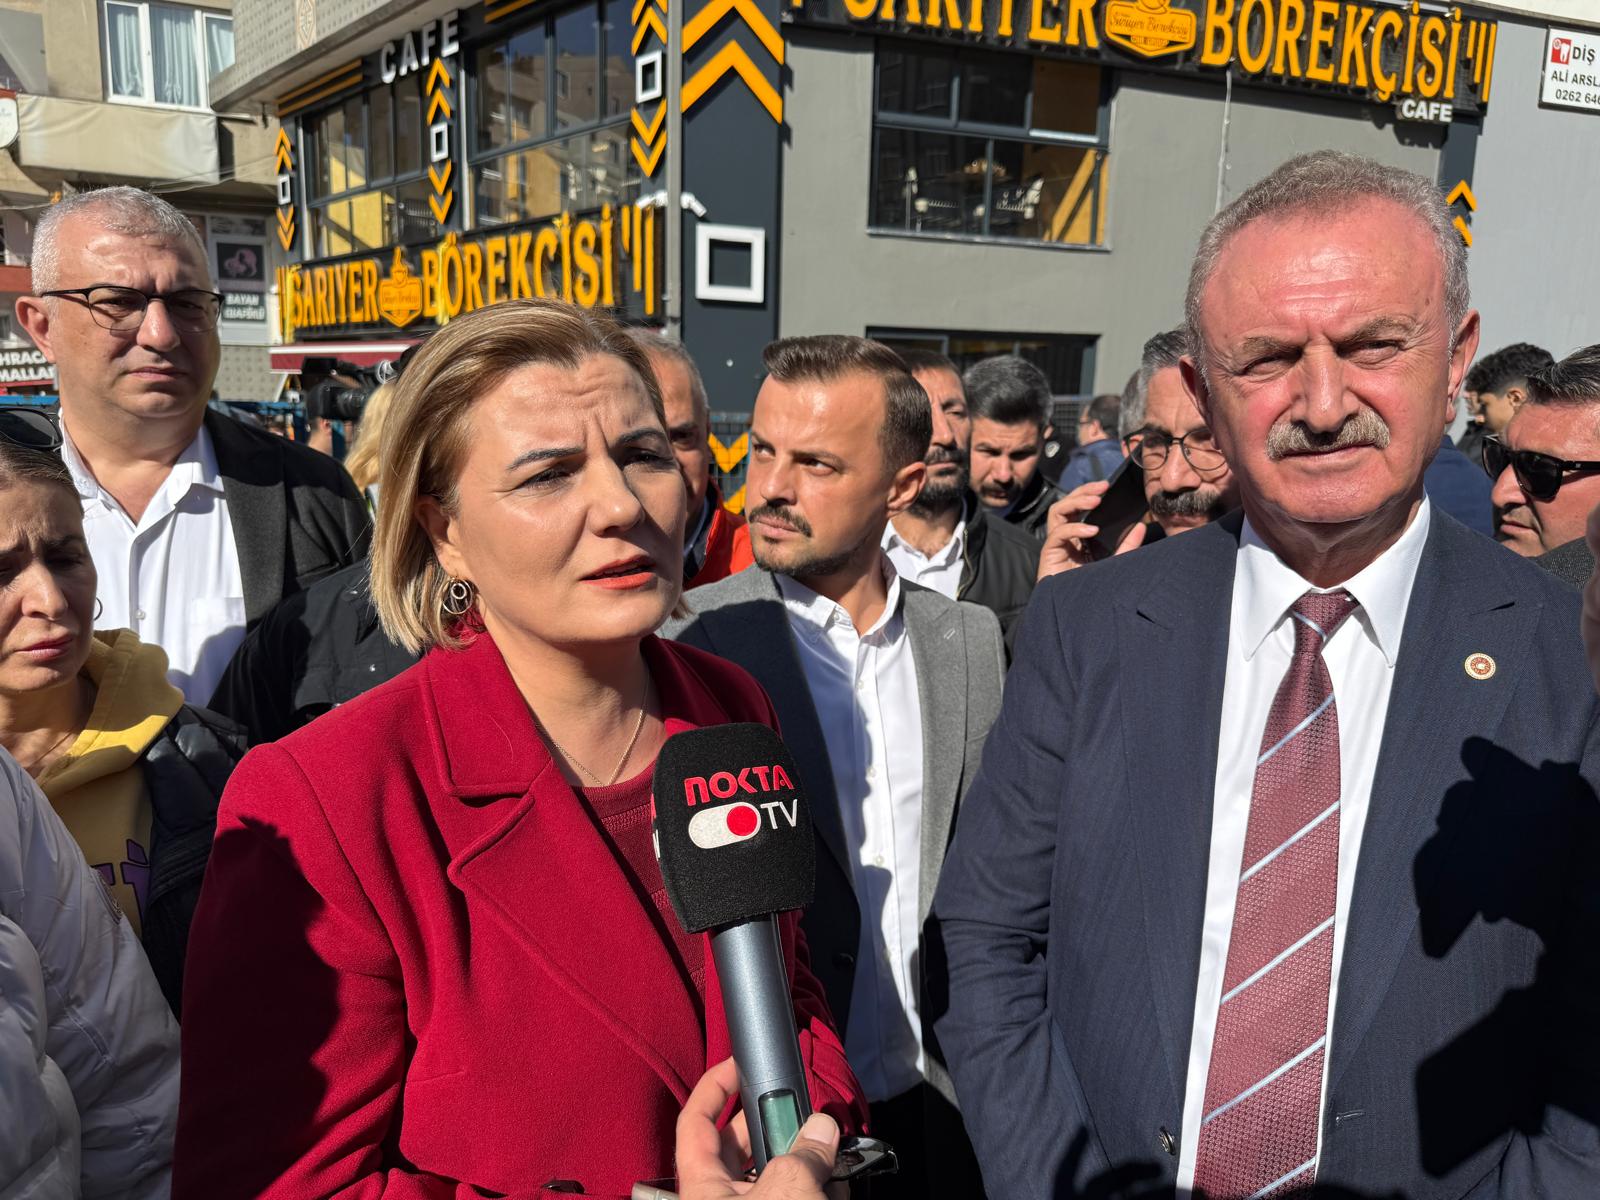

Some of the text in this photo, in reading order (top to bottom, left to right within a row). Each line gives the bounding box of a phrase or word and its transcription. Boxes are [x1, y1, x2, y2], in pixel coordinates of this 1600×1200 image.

[381, 9, 460, 84] CAFE
[1572, 45, 1596, 65] DİŞ
[1551, 69, 1600, 87] ALİ ARSL
[1555, 89, 1581, 102] 0262
[1402, 99, 1453, 122] CAFE
[290, 258, 380, 327] SARIYER
[760, 799, 797, 830] TV
